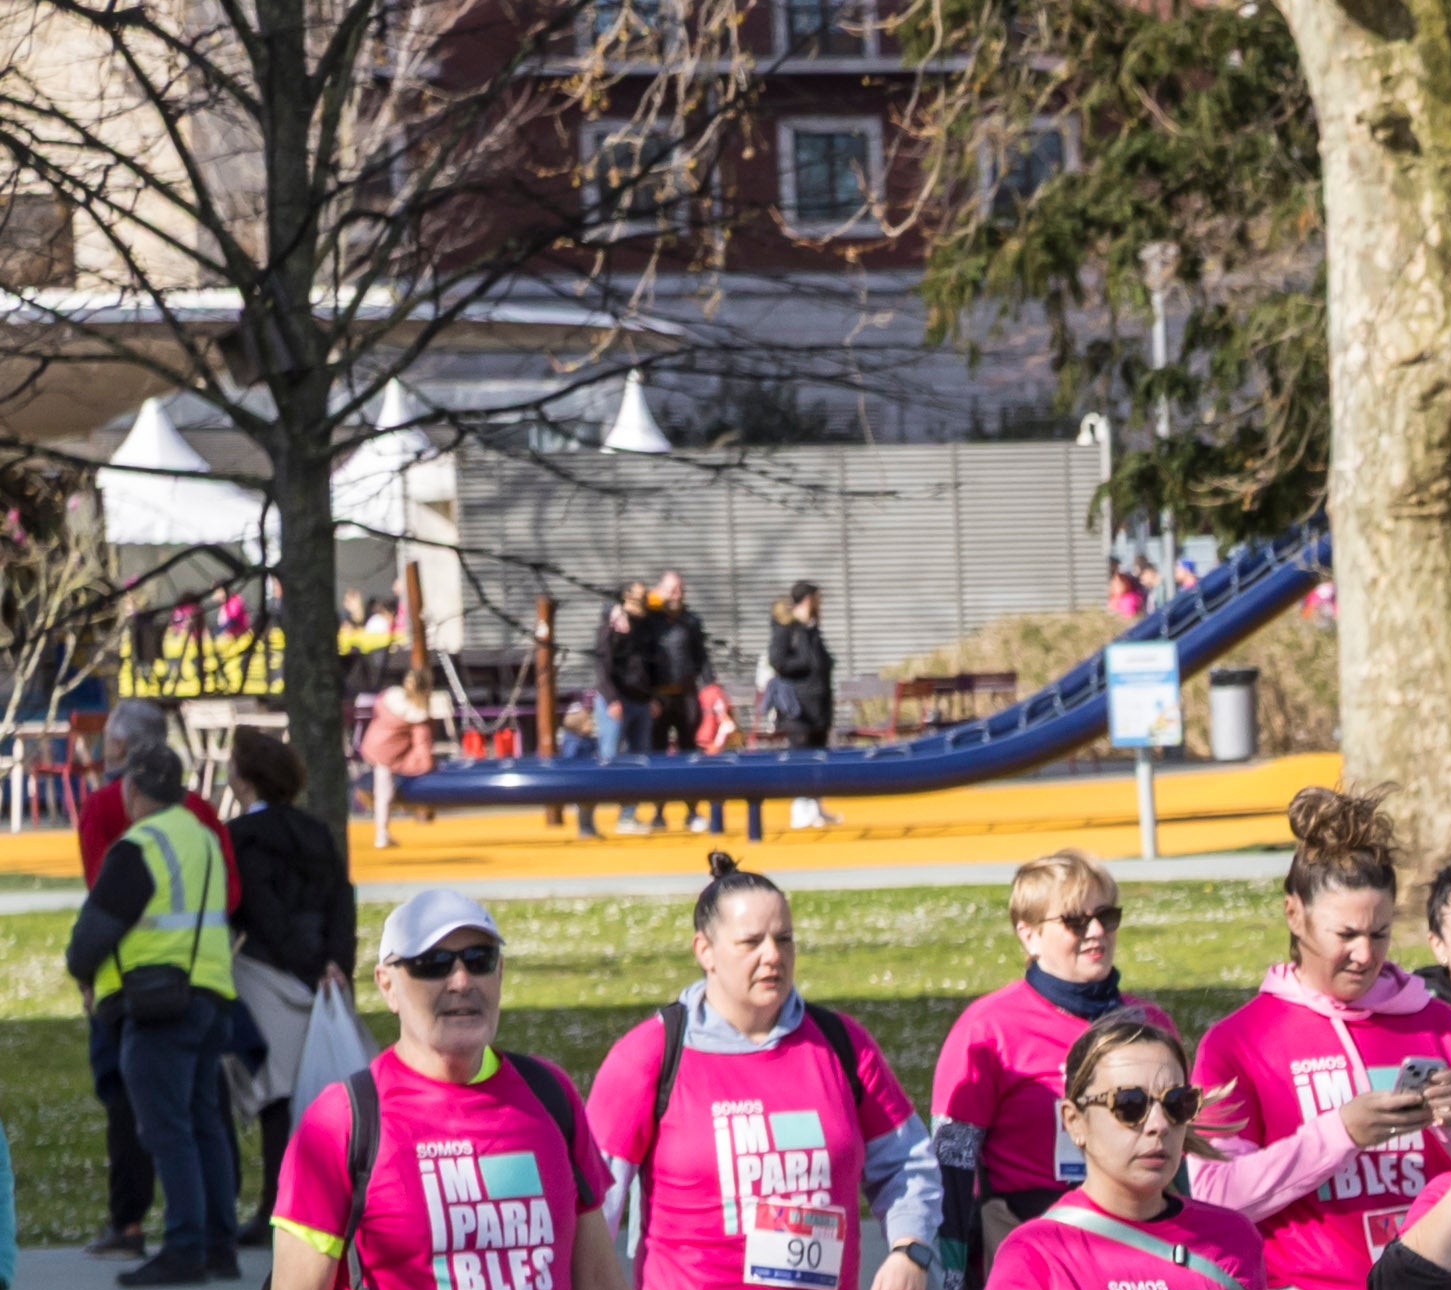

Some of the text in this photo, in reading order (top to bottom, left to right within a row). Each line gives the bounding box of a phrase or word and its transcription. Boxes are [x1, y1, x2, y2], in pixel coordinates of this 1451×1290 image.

[1290, 1054, 1347, 1075] SOMOS
[711, 1099, 763, 1116] SOMOS
[416, 1140, 473, 1158] SOMOS
[737, 1149, 832, 1196] PARA
[1335, 1152, 1426, 1199] BLES
[449, 1198, 555, 1250] PARA
[787, 1238, 822, 1269] 90
